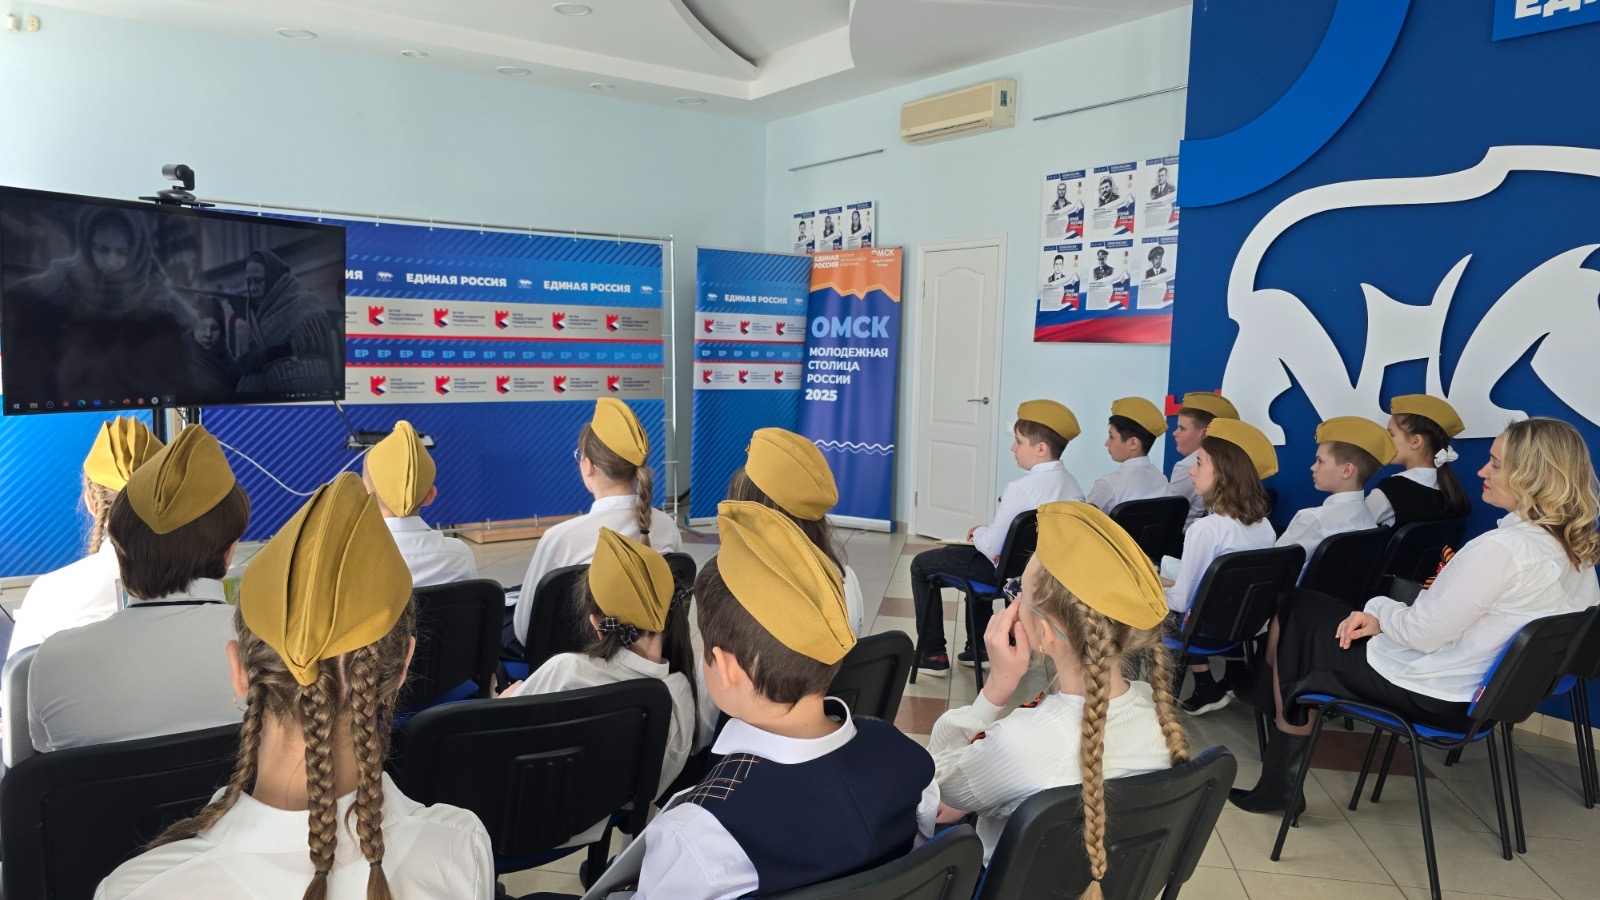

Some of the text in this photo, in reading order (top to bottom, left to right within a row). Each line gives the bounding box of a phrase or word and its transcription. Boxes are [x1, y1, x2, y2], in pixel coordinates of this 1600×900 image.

[406, 273, 507, 287] ЕДИНАЯ РОССИЯ
[543, 280, 631, 293] ЕДИНАЯ РОССИЯ
[724, 294, 788, 304] ЕДИНАЯ РОССИЯ
[811, 316, 890, 338] ОМСК
[809, 347, 888, 358] МОЛОДЕЖНАЯ
[808, 360, 860, 371] СТОЛИЦА
[807, 374, 850, 384] РОССИИ
[805, 388, 838, 401] 2025
